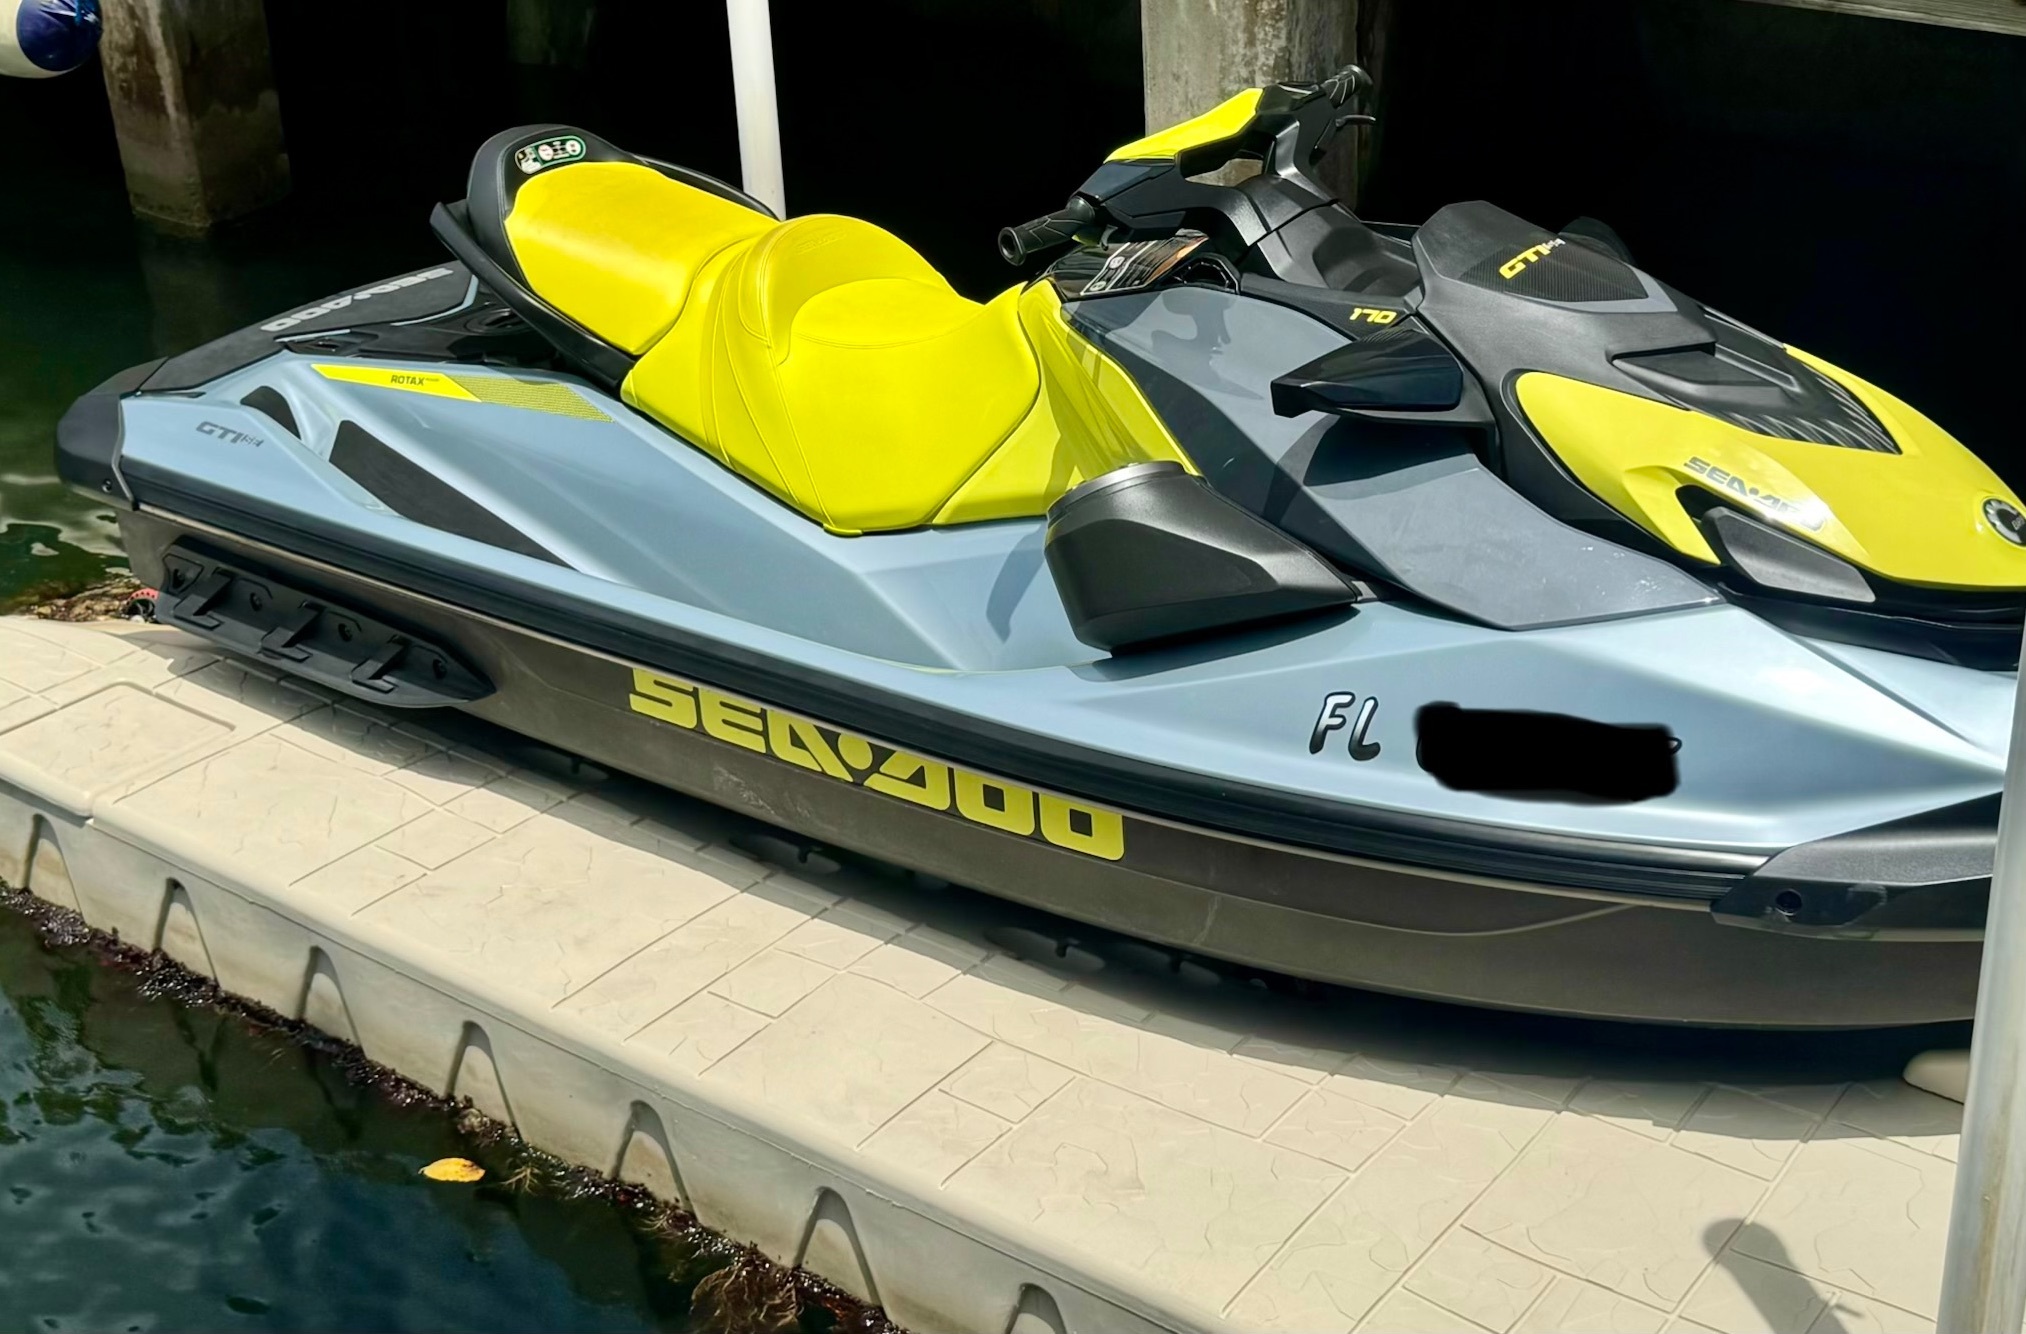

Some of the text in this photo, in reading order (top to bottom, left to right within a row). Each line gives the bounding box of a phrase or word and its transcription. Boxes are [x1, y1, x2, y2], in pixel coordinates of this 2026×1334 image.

[1499, 244, 1551, 279] GTI
[1349, 307, 1397, 324] 170
[390, 374, 425, 386] ROTAX
[196, 421, 244, 444] GTI
[1309, 691, 1381, 761] FL
